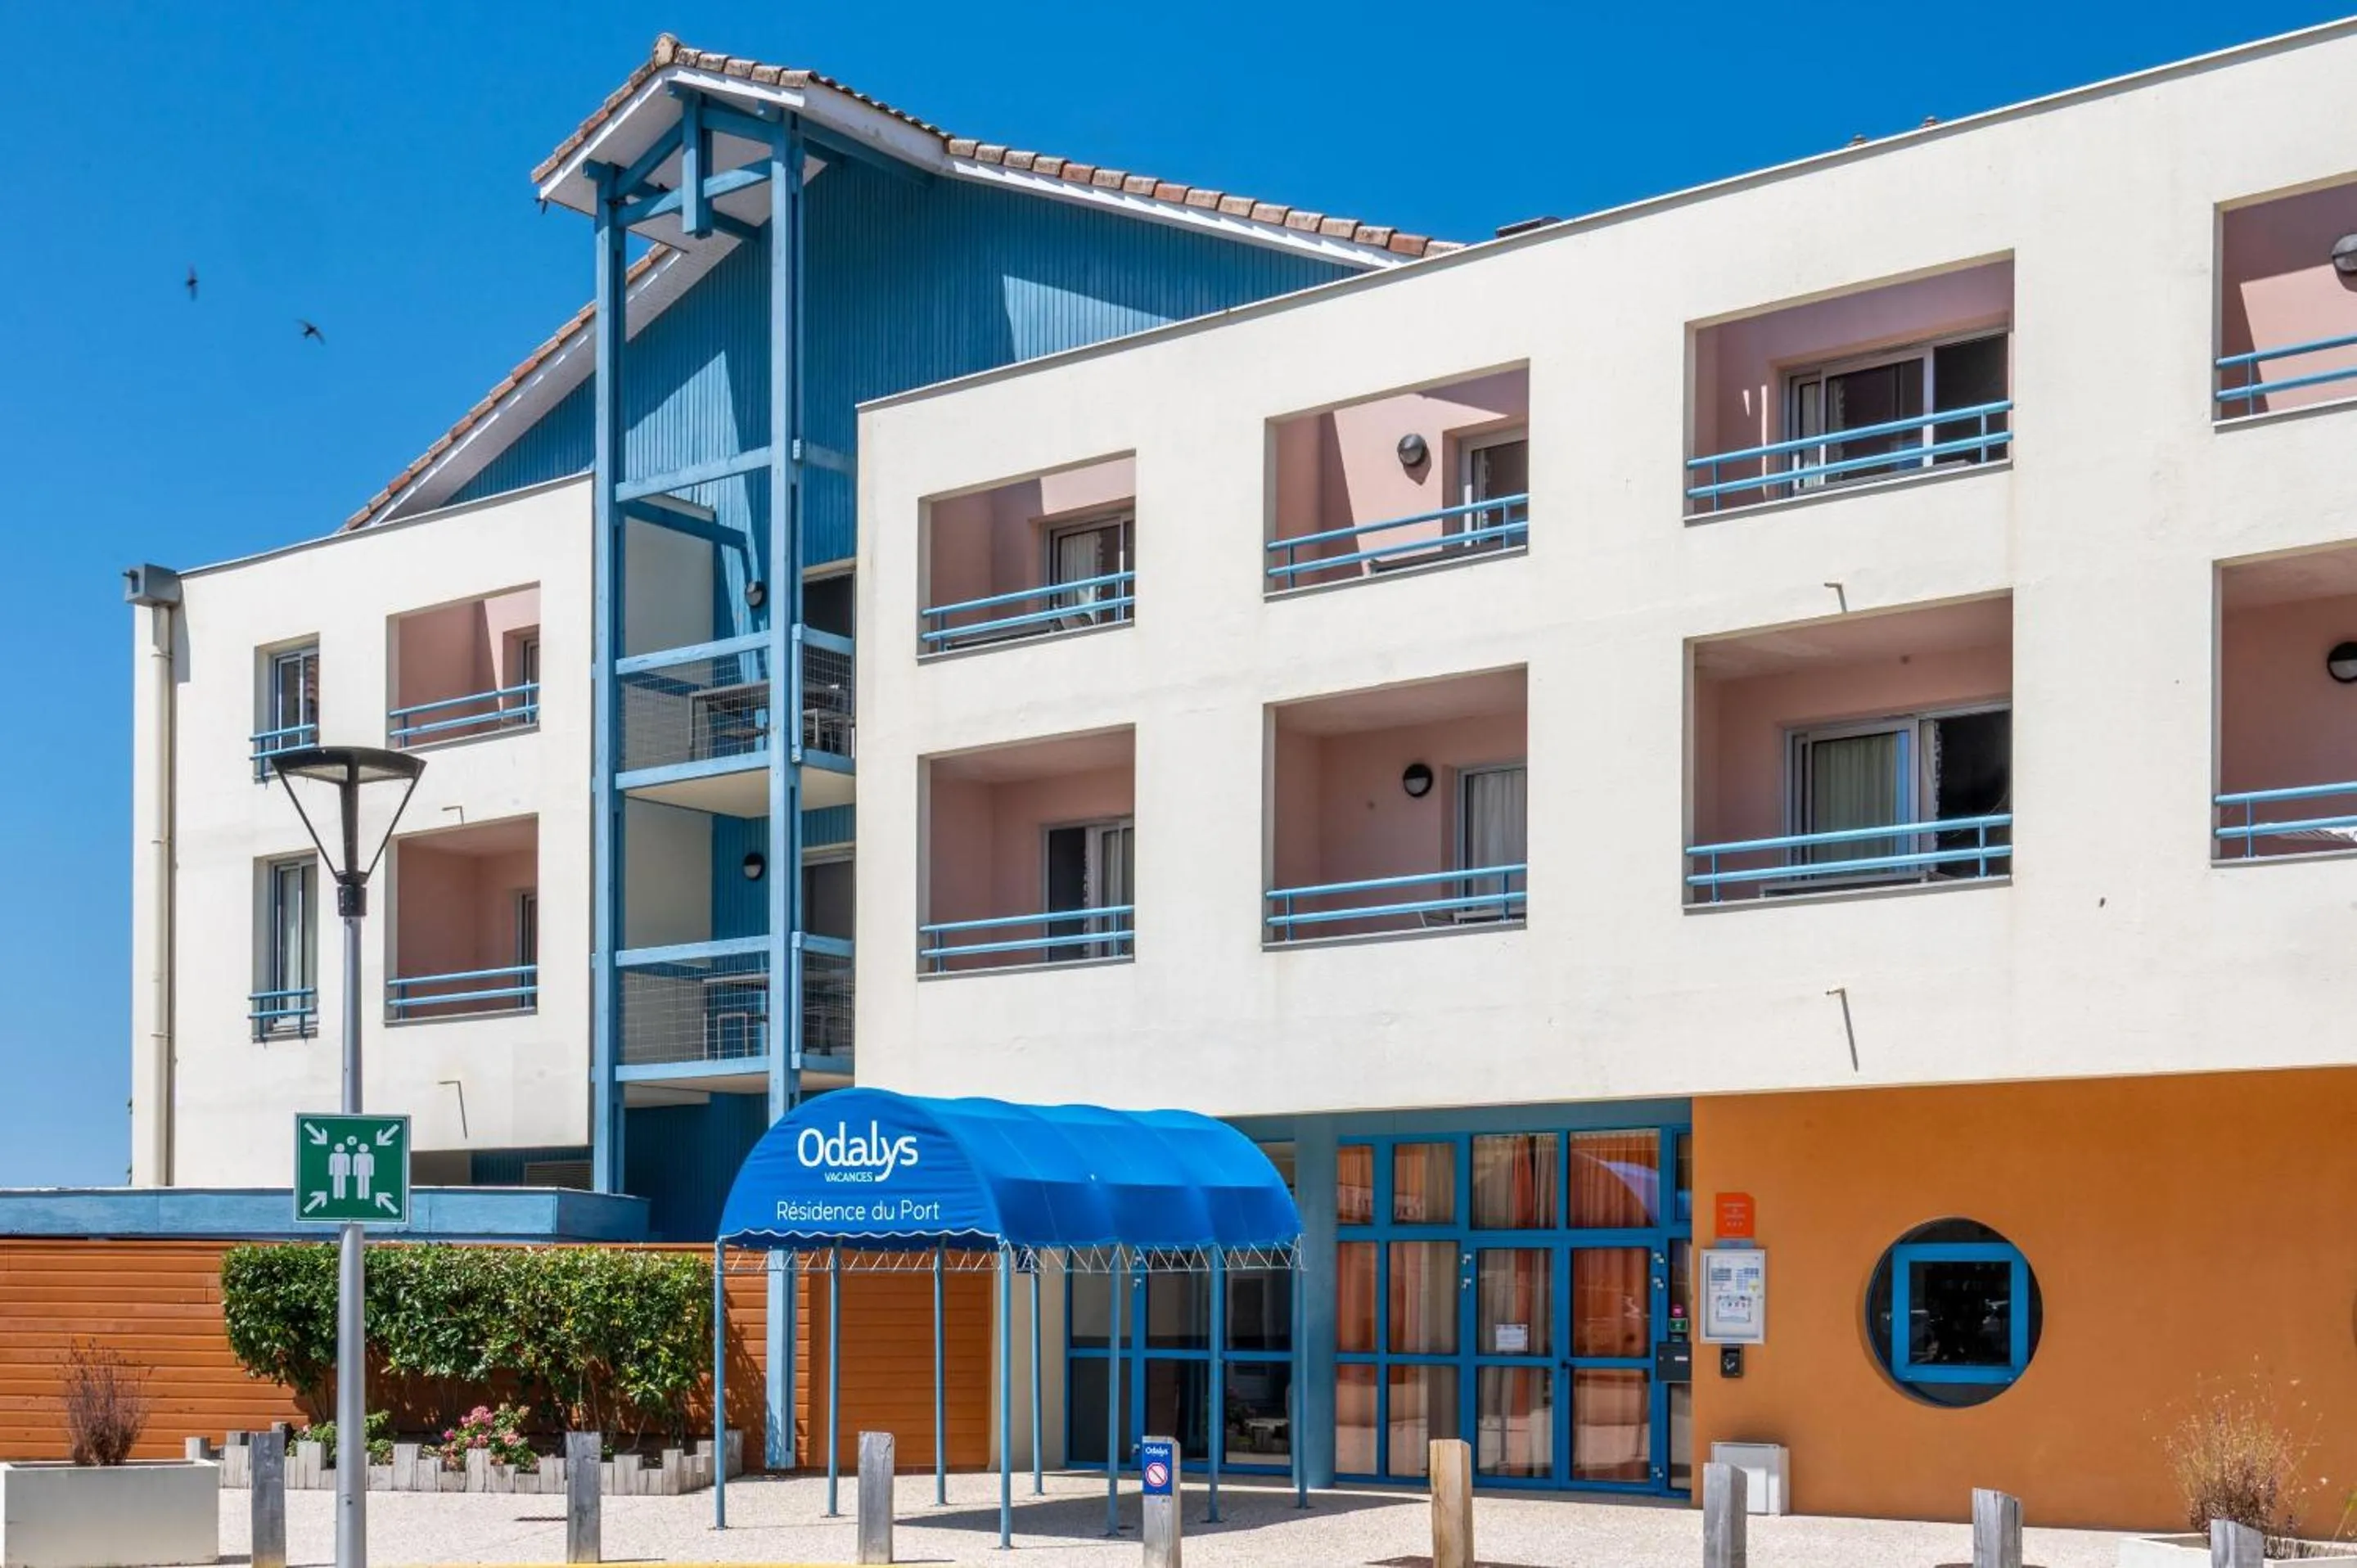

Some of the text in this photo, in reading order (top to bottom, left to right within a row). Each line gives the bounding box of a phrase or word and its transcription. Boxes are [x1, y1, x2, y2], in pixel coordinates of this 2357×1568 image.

[797, 1120, 919, 1183] Odalys
[824, 1171, 873, 1183] VACANCES
[777, 1199, 940, 1221] Résidence du Port
[1145, 1446, 1169, 1457] Odalys
